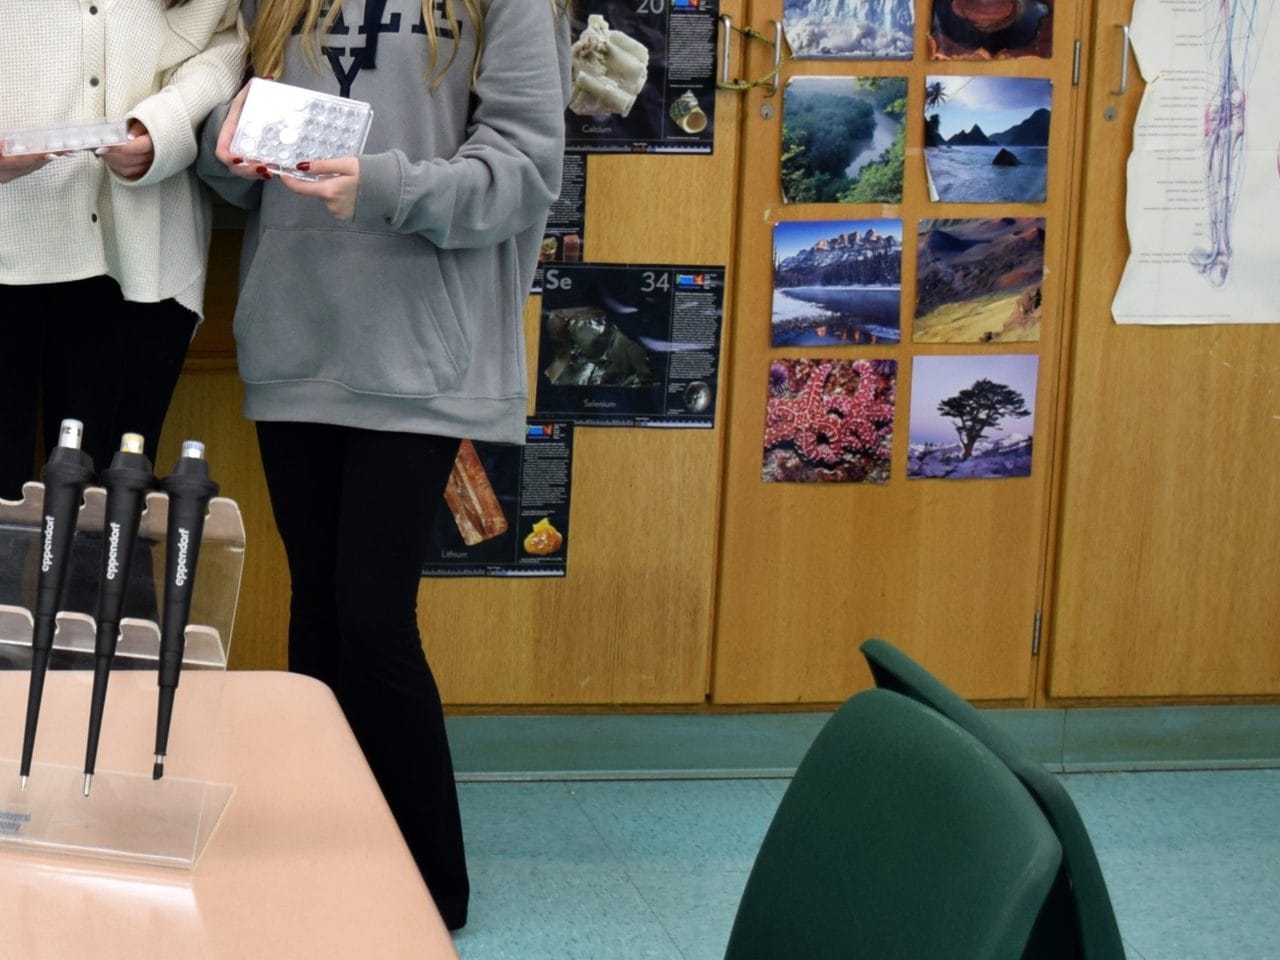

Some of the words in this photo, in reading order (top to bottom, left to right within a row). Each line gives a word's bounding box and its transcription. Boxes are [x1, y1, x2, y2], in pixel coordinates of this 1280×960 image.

[582, 124, 612, 133] Calcium
[546, 269, 572, 290] Se
[640, 271, 670, 292] 34
[583, 399, 616, 409] Selenium
[41, 515, 55, 572] eppendorf
[106, 521, 120, 580] eppendorf
[175, 527, 190, 587] eppendorf
[441, 550, 468, 559] Lithium
